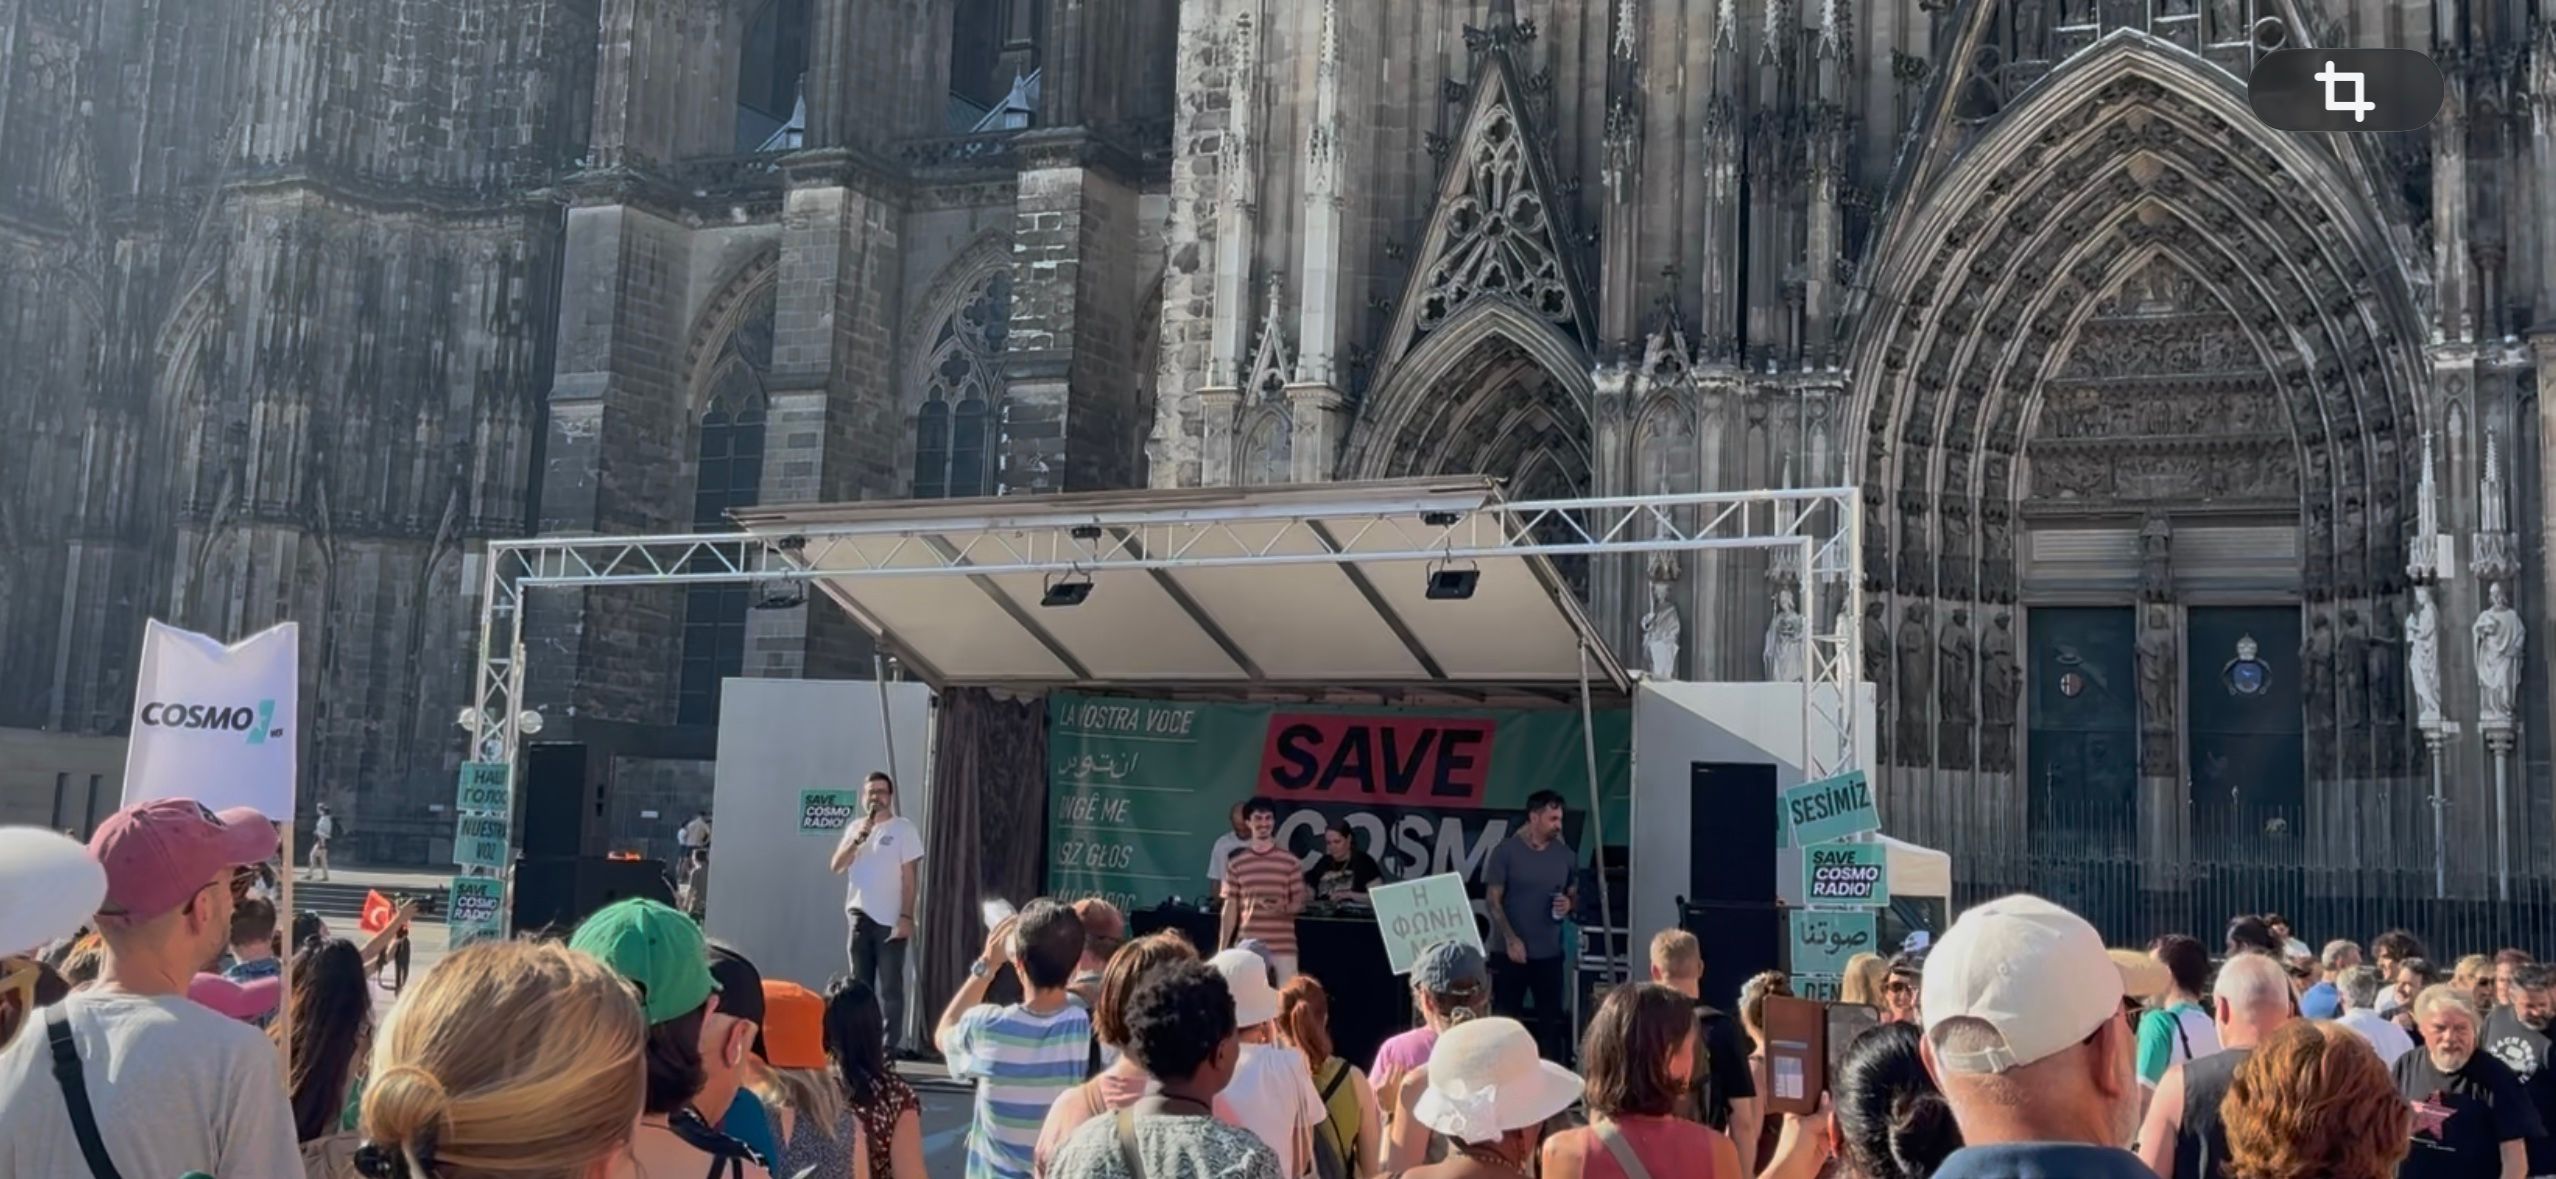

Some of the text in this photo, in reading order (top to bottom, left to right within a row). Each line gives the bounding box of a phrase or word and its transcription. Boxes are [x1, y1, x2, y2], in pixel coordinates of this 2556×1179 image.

[142, 702, 254, 732] COSMO
[1146, 708, 1195, 734] VOCE
[1270, 723, 1485, 798] SAVE
[805, 794, 837, 805] SAVE
[806, 806, 850, 817] COSMO
[1100, 797, 1131, 823] ME
[1790, 779, 1872, 826] SESİMİZ
[1085, 843, 1133, 869] GŁOS
[1274, 807, 1567, 884] COSM
[1812, 850, 1857, 865] SAVE
[1815, 866, 1879, 881] COSMO
[1812, 882, 1871, 897] RADIO!
